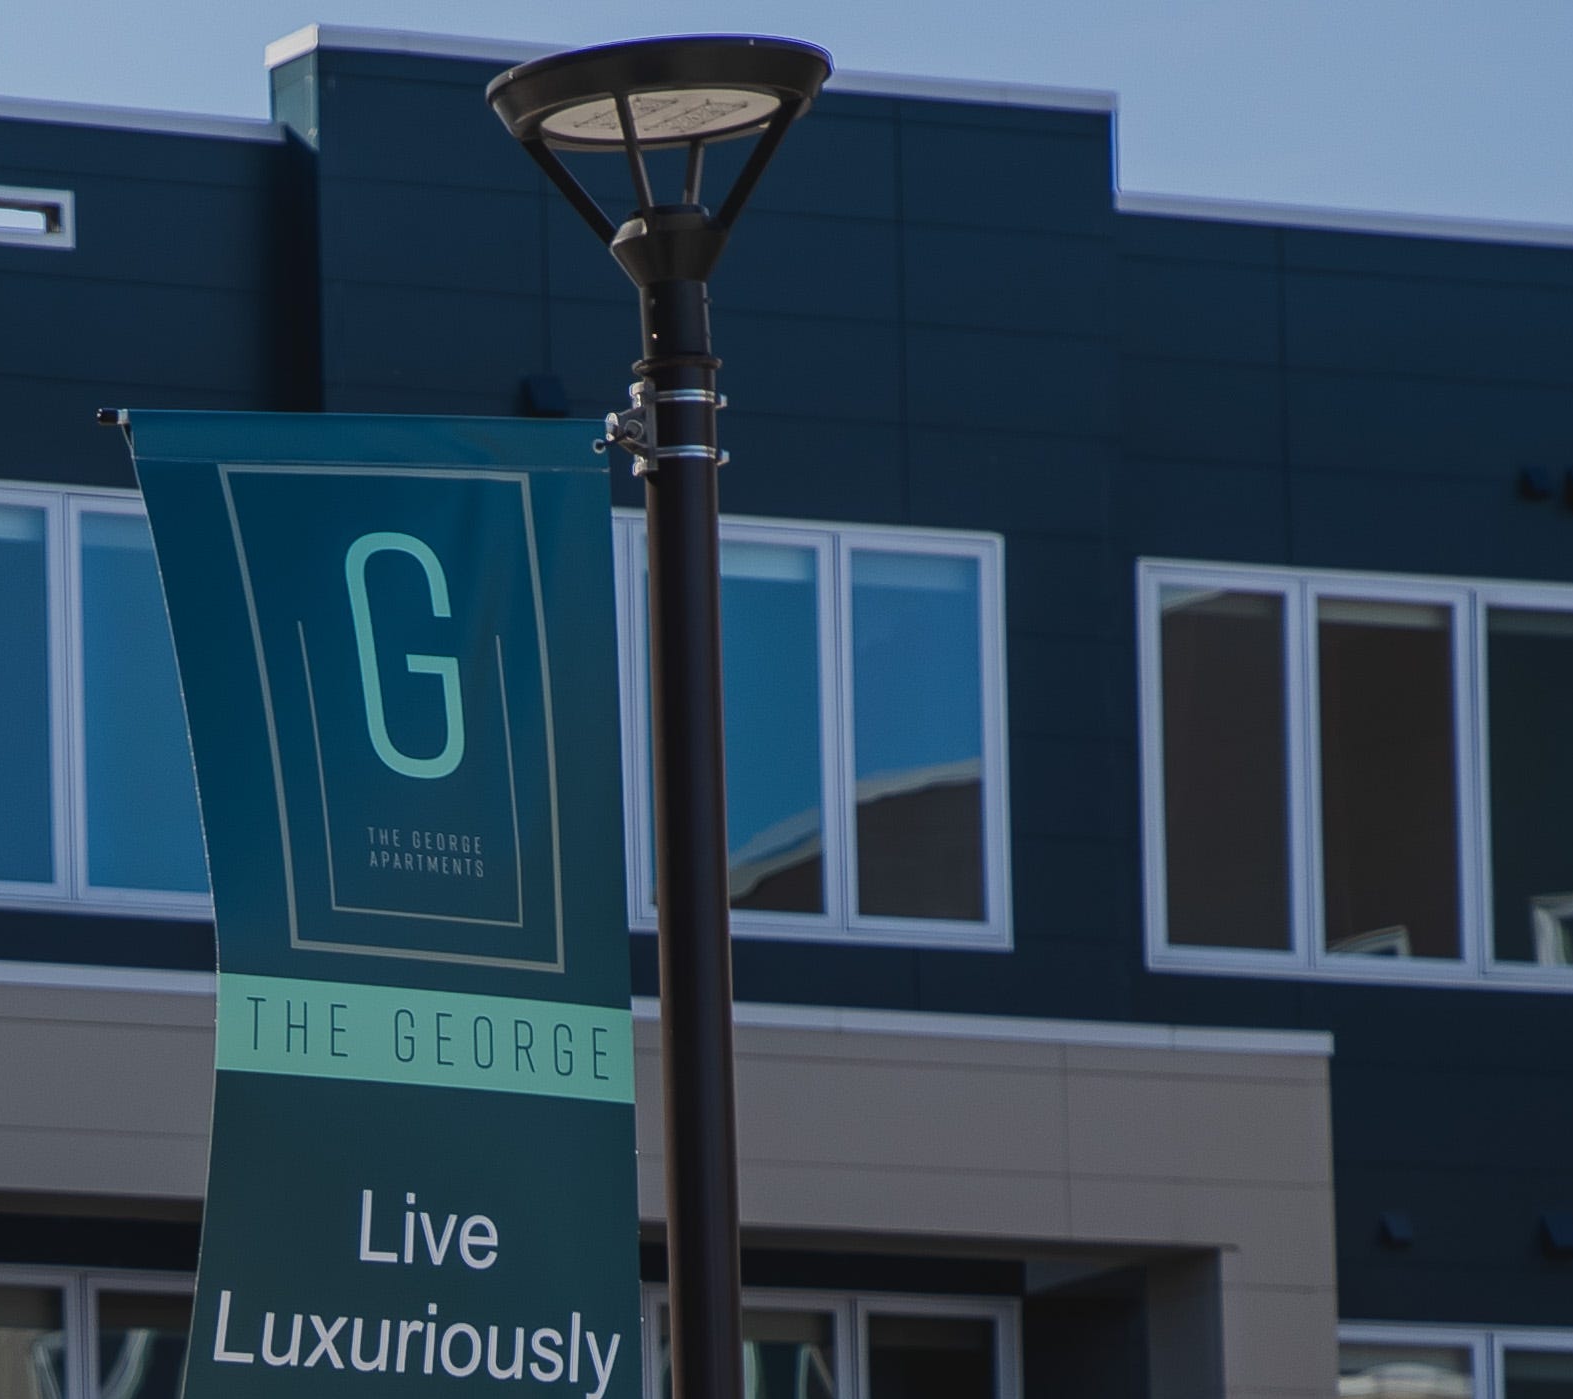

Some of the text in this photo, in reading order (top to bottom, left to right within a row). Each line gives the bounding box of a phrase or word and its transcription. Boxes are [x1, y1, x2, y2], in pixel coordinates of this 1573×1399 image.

[344, 531, 466, 780] G
[367, 826, 482, 855] THE GEORGE
[369, 850, 484, 878] APARTMENTS
[246, 995, 610, 1081] THE GEORGE
[359, 1189, 499, 1270] Live
